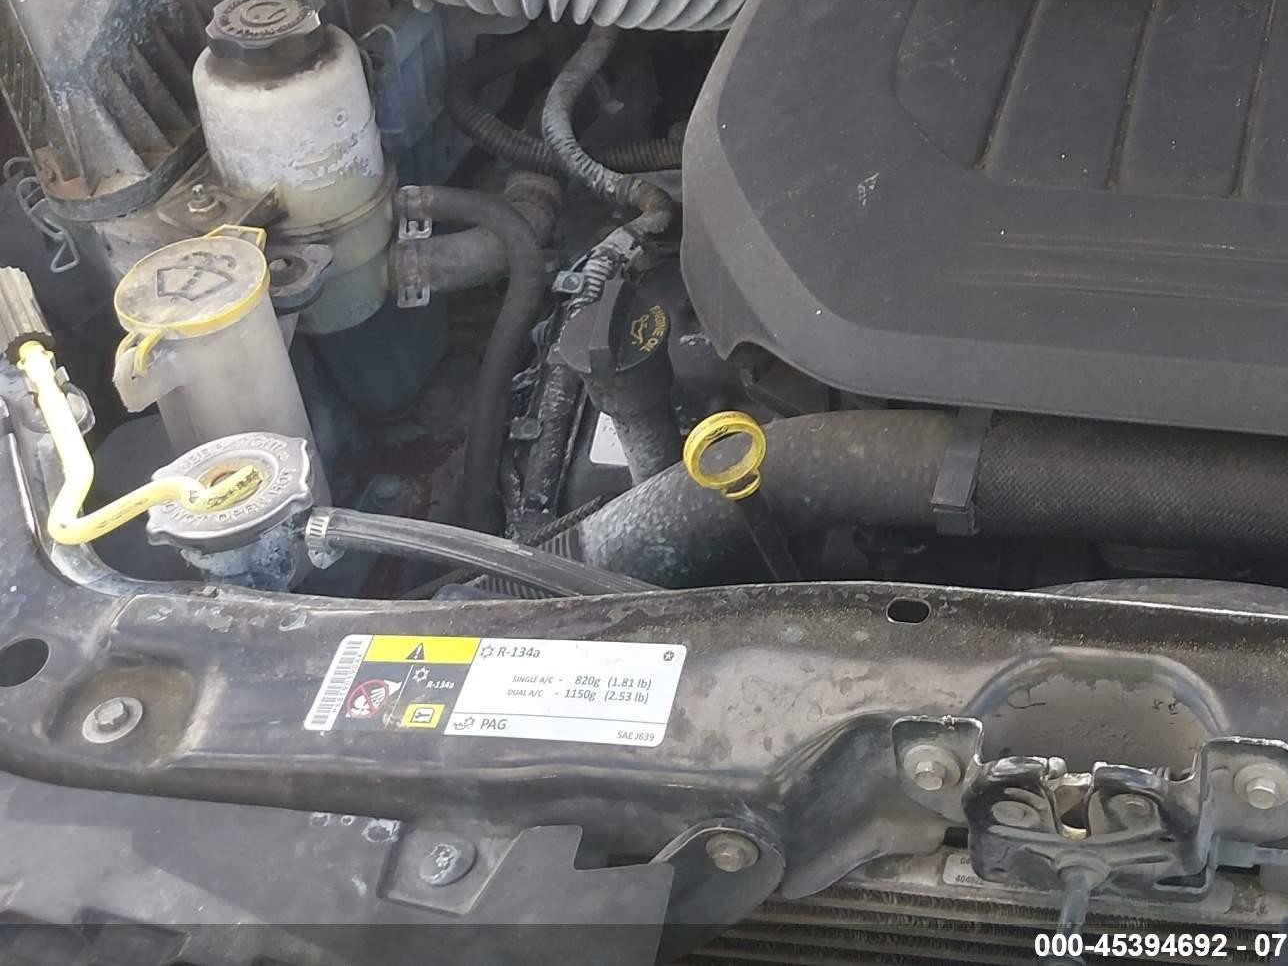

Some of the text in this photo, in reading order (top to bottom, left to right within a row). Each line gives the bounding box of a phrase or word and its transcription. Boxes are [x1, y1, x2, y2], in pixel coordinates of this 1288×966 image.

[495, 645, 542, 659] R-134a
[511, 674, 539, 683] SINGLE
[572, 675, 601, 687] 820g
[606, 676, 636, 688] (1.81
[635, 678, 653, 689] lb)
[562, 688, 597, 701] 1150g
[602, 690, 633, 701] (2.53
[633, 691, 650, 703] lb)
[478, 718, 509, 730] PAG
[615, 731, 655, 742] SAE J639
